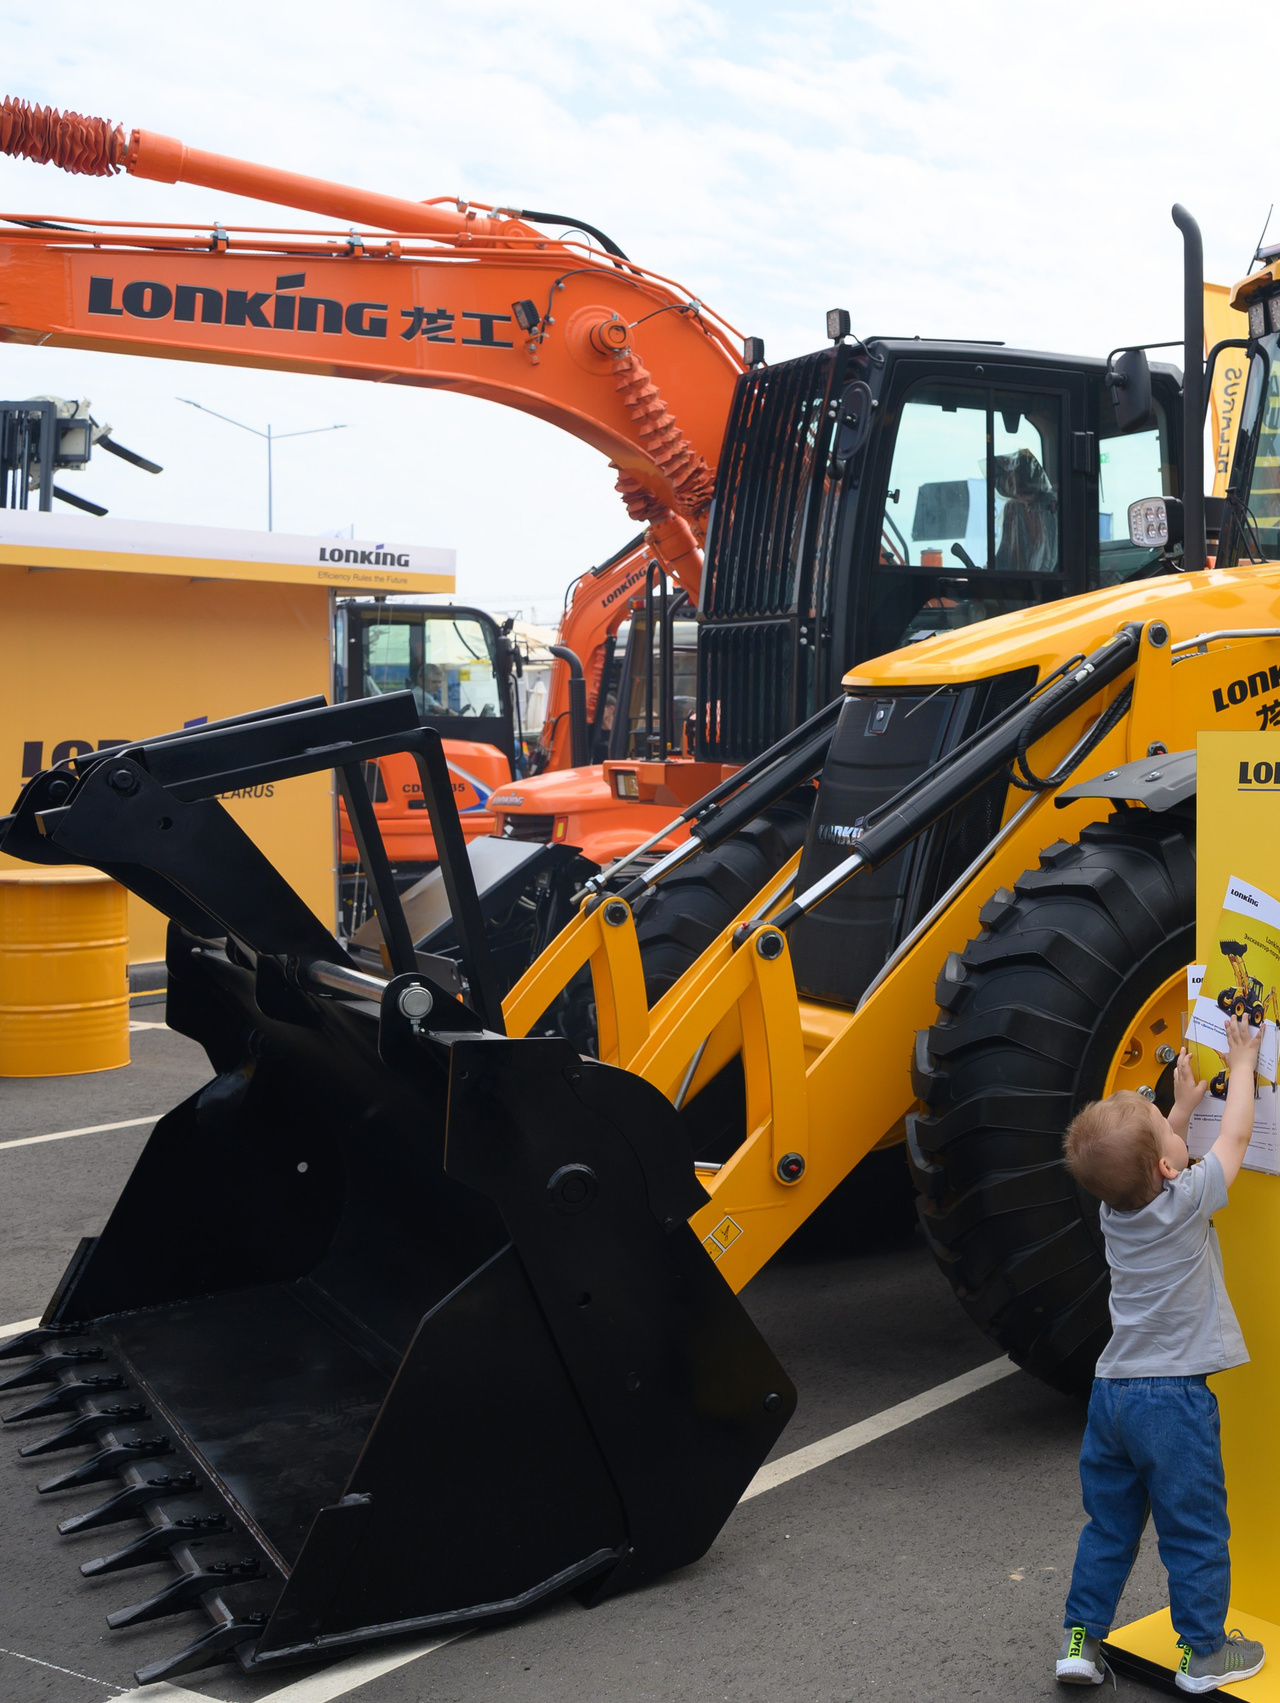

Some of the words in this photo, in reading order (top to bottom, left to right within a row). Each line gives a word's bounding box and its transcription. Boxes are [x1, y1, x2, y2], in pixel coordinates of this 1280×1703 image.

[399, 305, 514, 349] 龙工
[318, 543, 411, 568] LONKING
[317, 571, 351, 583] Efficiency
[352, 573, 373, 583] Rules
[373, 575, 385, 583] the
[386, 576, 409, 585] Future
